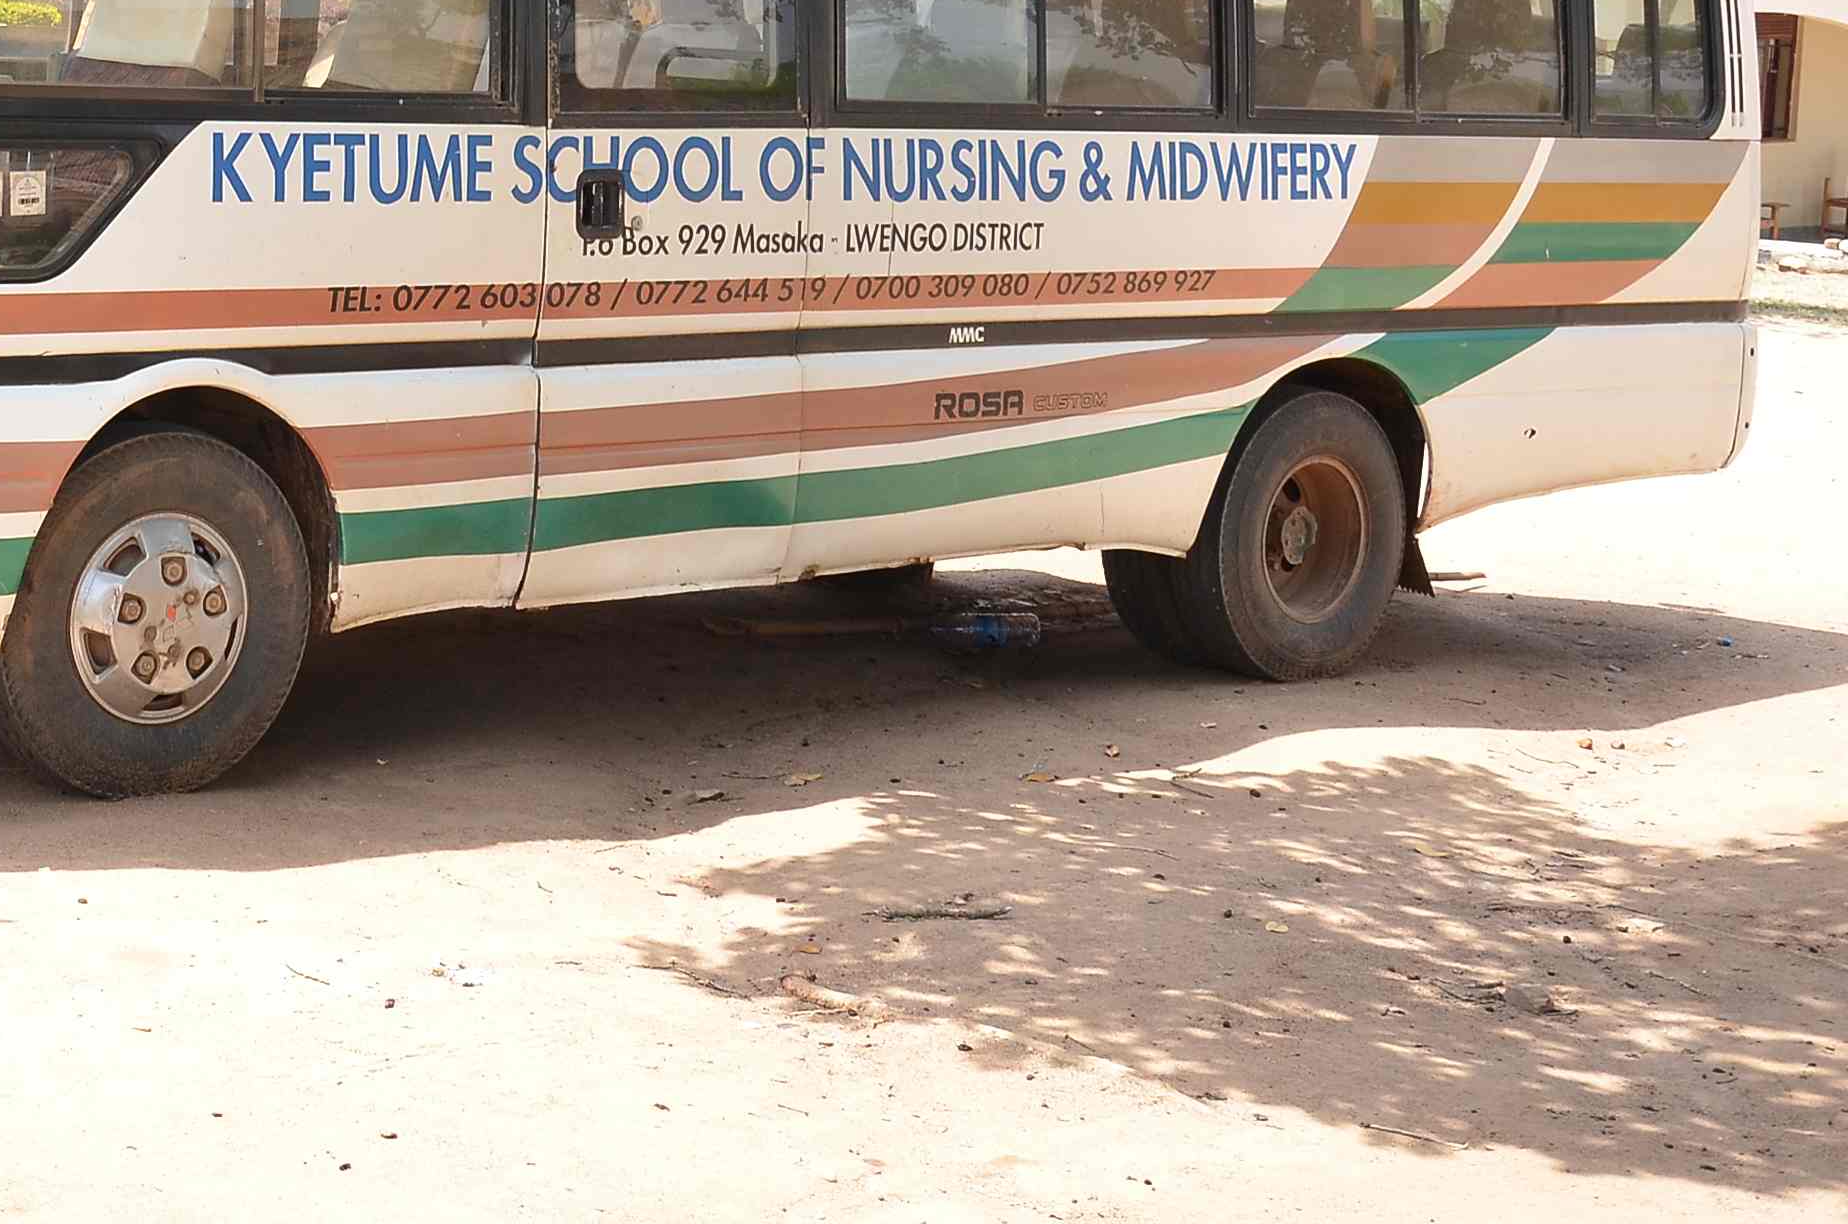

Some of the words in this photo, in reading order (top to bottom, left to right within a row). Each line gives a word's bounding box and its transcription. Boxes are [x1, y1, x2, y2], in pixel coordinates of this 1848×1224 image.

[212, 132, 493, 204] KYETUME
[511, 134, 742, 204] SCHOOL
[760, 136, 825, 202] OF
[842, 137, 1066, 203] NURSING
[1079, 141, 1111, 201] &
[1126, 141, 1357, 202] MIDWIFERY
[622, 226, 669, 256] Box
[678, 224, 726, 255] 929
[732, 220, 824, 255] Masaka
[846, 223, 947, 252] LWENGO
[953, 222, 1044, 251] DISTRICT
[328, 286, 381, 313] TEL:
[392, 284, 472, 311] 0772
[480, 283, 536, 309] 603
[546, 281, 601, 308] 078
[636, 279, 708, 306] 0772
[716, 277, 768, 304] 644
[856, 275, 920, 300] 0700
[928, 274, 975, 299] 309
[982, 273, 1029, 297] 080
[1057, 271, 1117, 295] 0752
[1123, 271, 1167, 294] 869
[1174, 269, 1216, 292] 927
[949, 326, 984, 343] MMC
[934, 390, 1024, 420] ROSA
[1032, 391, 1108, 411] CUSTOM
